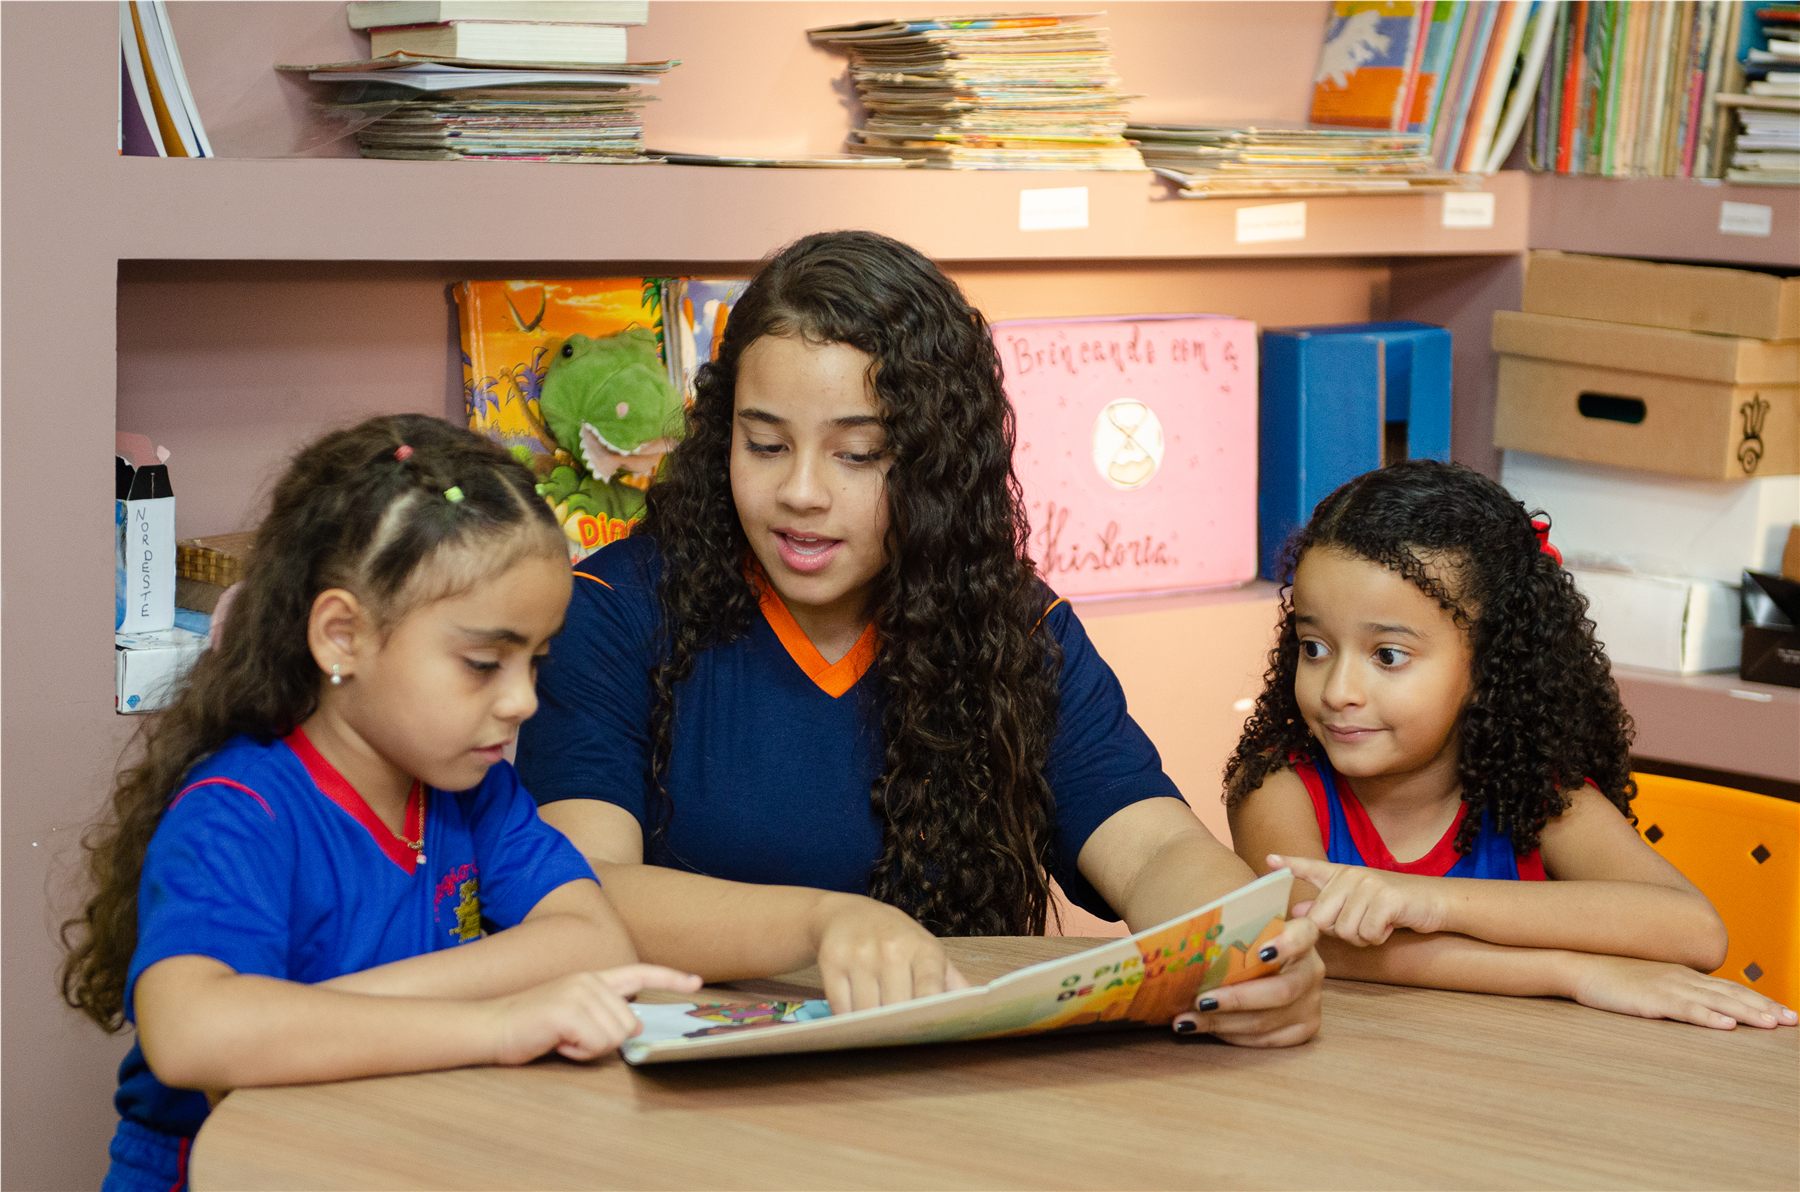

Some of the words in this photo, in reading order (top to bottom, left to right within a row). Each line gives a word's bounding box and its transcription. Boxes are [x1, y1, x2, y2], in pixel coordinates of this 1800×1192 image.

[1010, 324, 1156, 375] Brincando
[1171, 338, 1209, 372] com
[135, 507, 153, 617] NORDESTE
[1056, 983, 1096, 1002] DE
